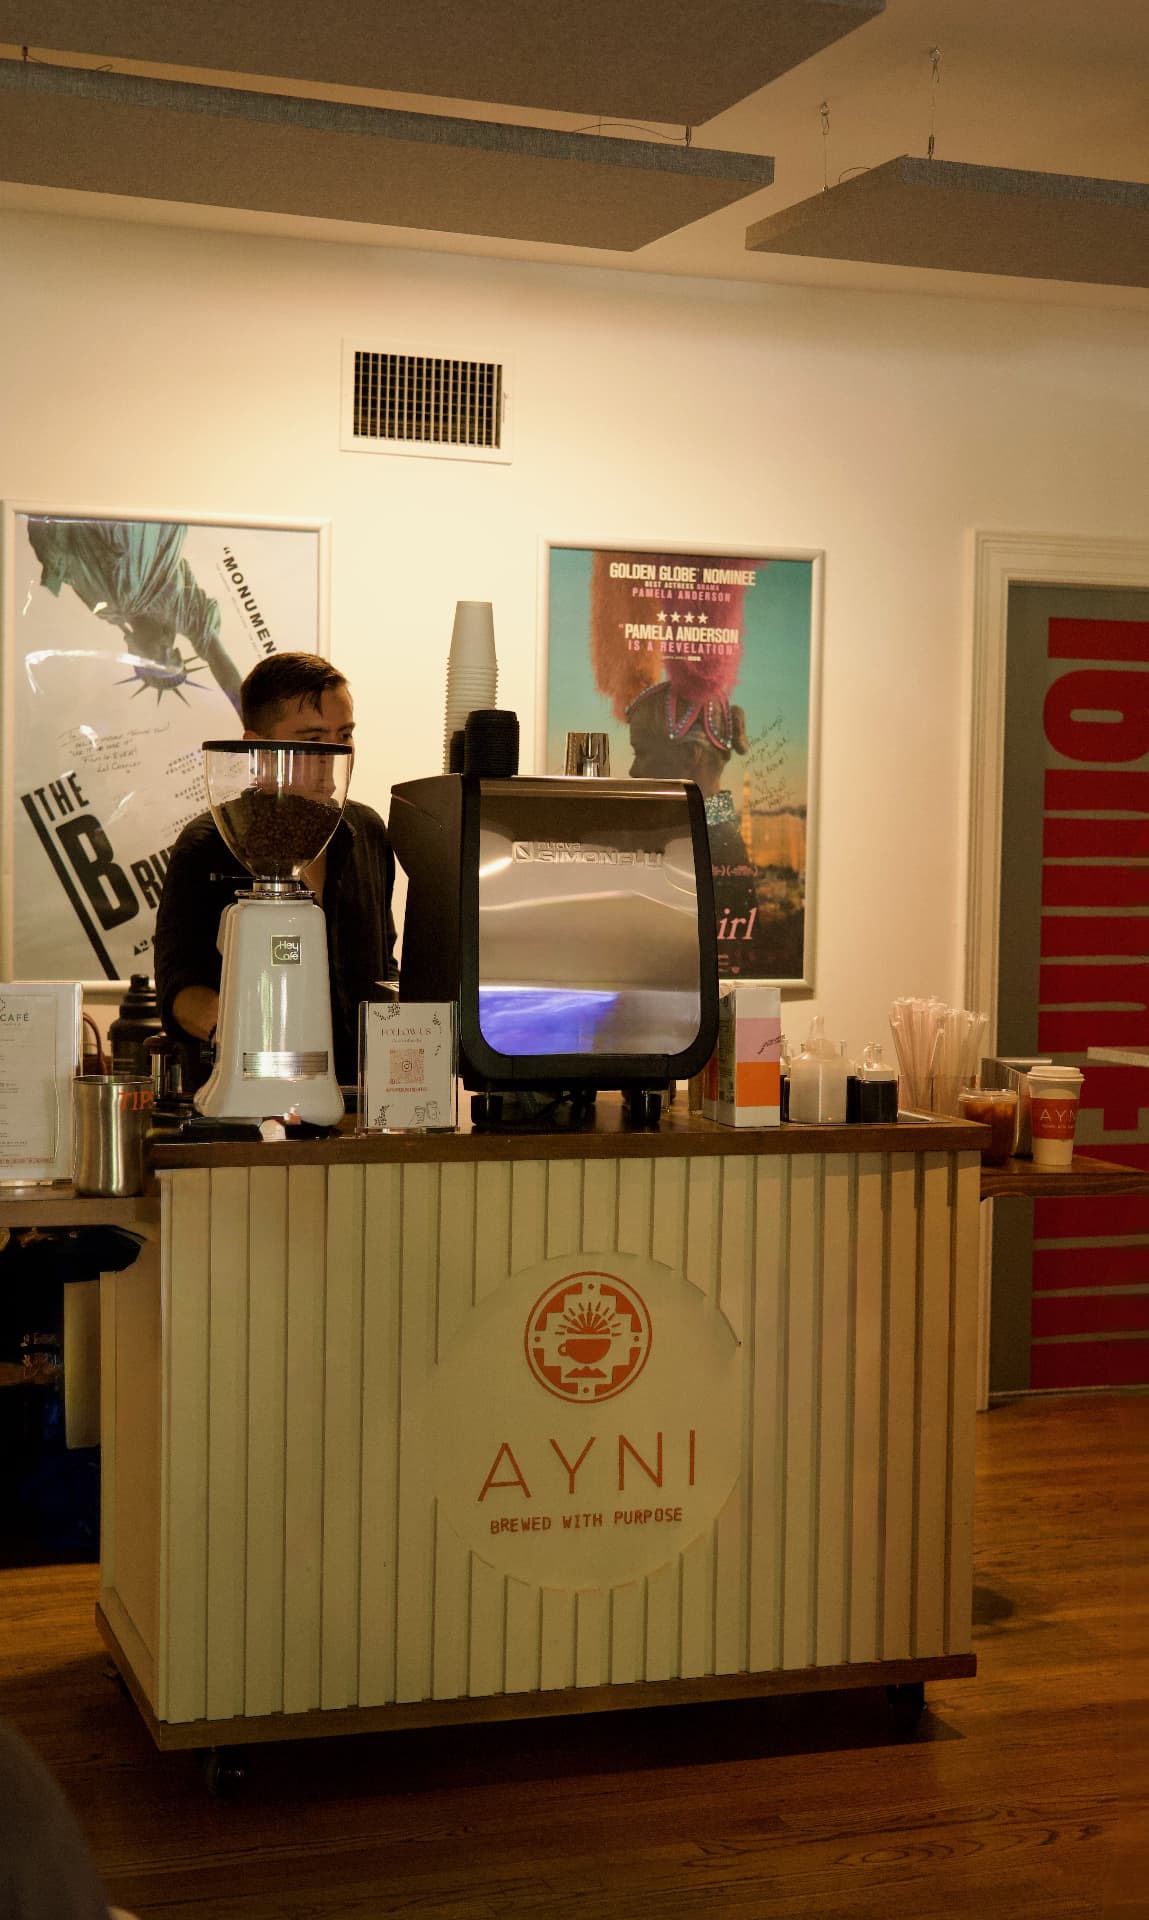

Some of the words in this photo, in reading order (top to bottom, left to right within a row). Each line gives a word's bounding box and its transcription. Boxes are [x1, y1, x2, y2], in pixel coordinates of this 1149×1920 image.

[609, 562, 656, 580] GOLDEN
[703, 568, 757, 586] NOMINEE
[632, 587, 673, 599] PAMELA
[678, 590, 732, 602] ANDERSON
[664, 581, 695, 590] ACTRESS
[675, 627, 739, 644] ANDERSON
[628, 640, 640, 651] IS
[647, 641, 653, 652] A
[34, 772, 90, 821] THE
[537, 850, 664, 870] SIMONELLI
[274, 943, 299, 961] Café
[279, 940, 299, 952] Hey
[476, 1429, 696, 1503] AYNI
[490, 1516, 552, 1535] BREWED
[562, 1512, 603, 1529] WITH
[614, 1507, 683, 1526] PURPOSE
